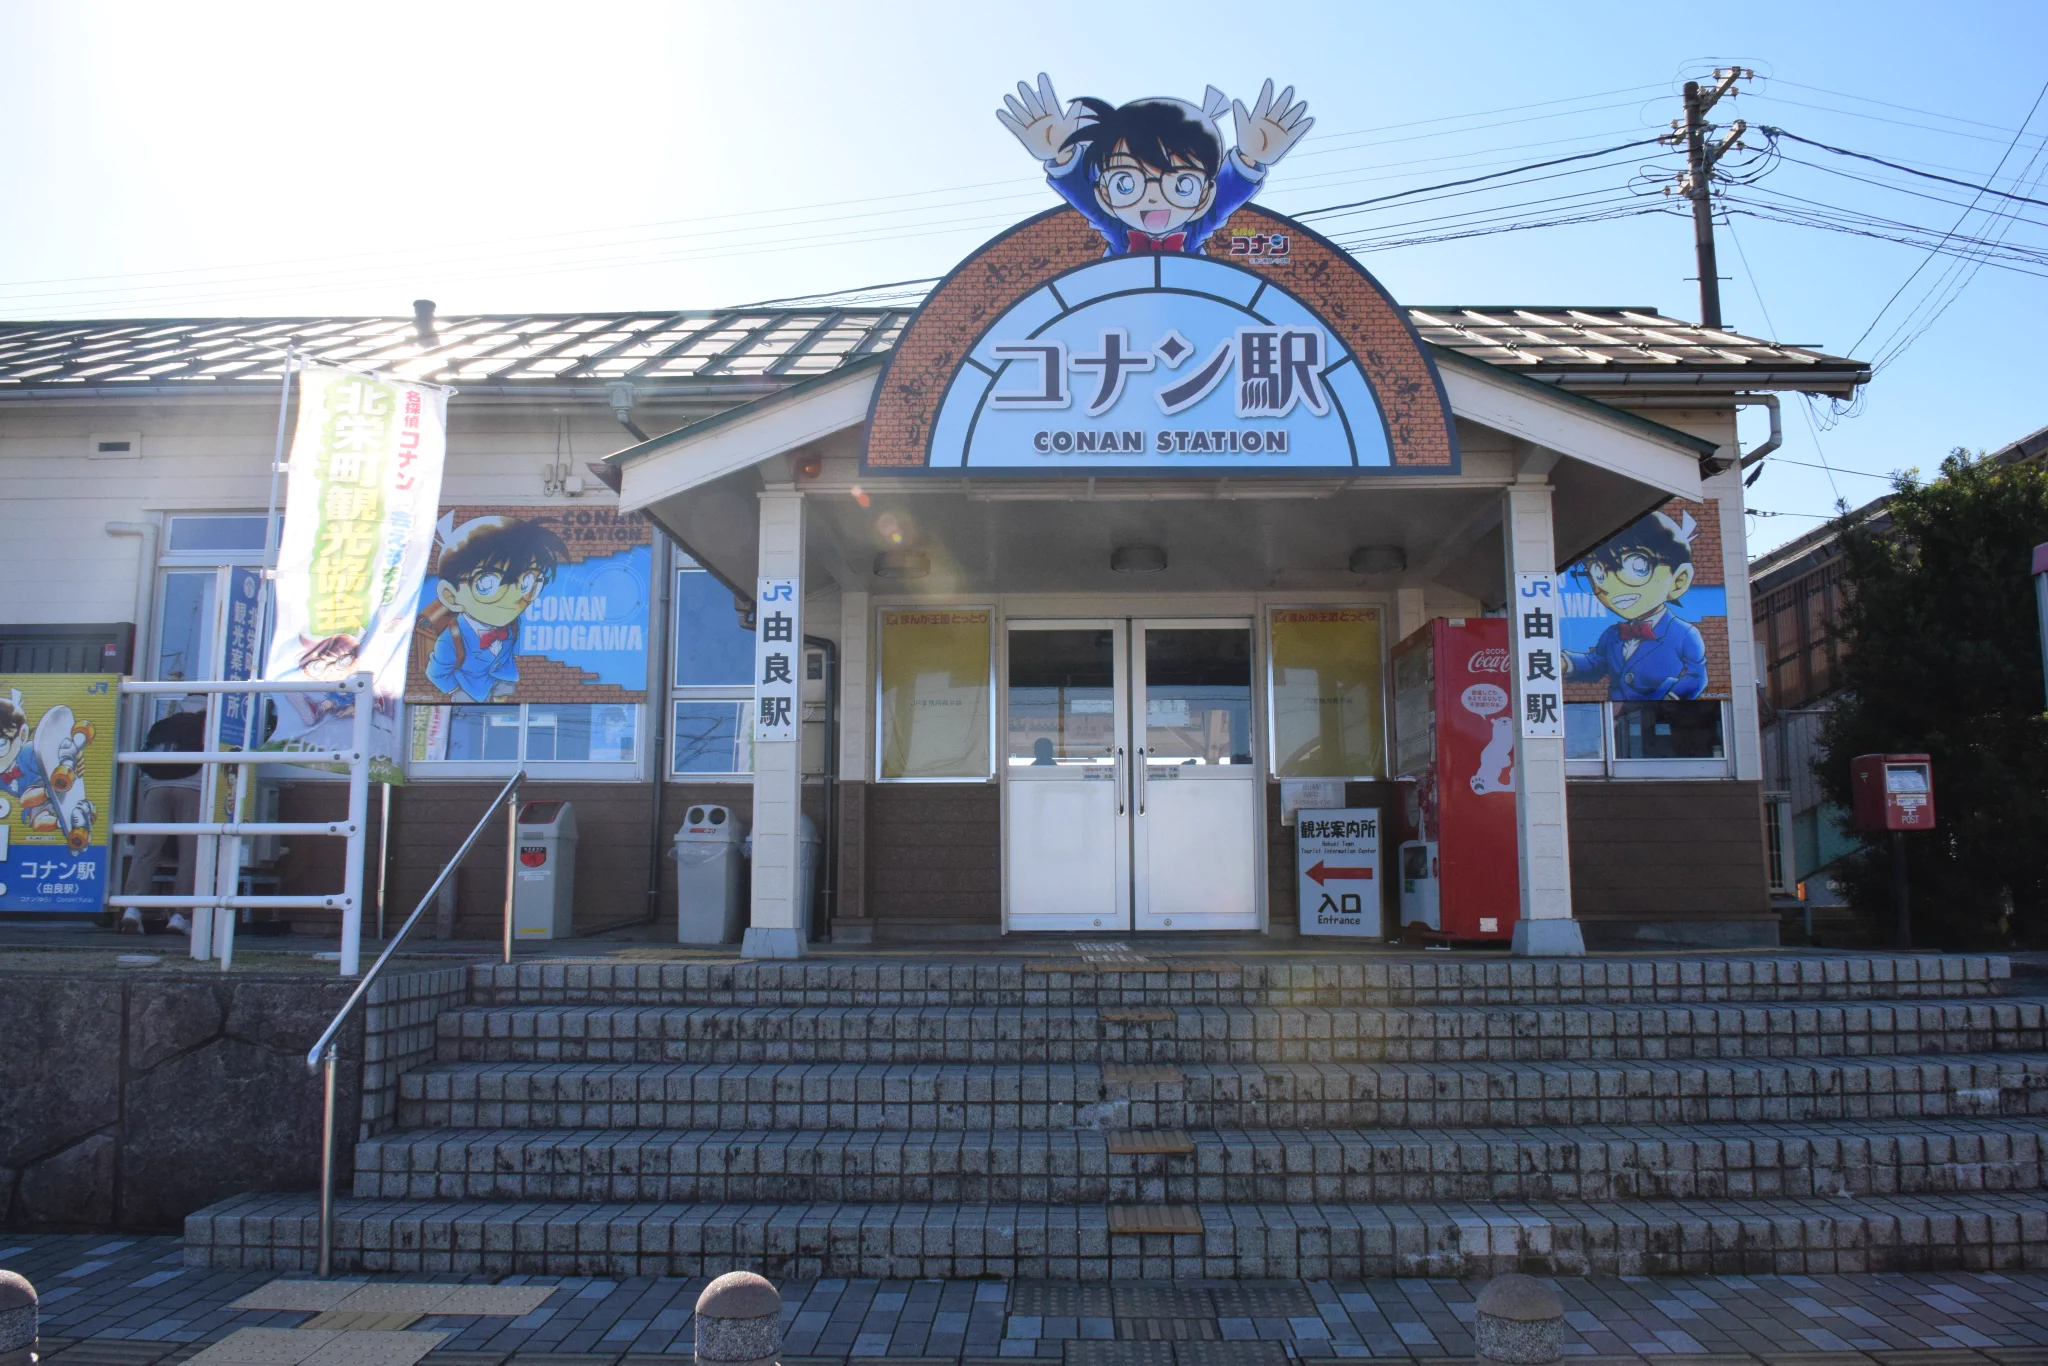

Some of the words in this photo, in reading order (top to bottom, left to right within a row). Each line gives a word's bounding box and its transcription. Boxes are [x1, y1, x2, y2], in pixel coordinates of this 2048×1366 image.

[1230, 234, 1290, 255] コナン
[992, 328, 1327, 414] コナン駅
[395, 390, 422, 490] 名探偵コナン
[1034, 431, 1143, 452] CONAN
[1156, 431, 1288, 452] STATION
[315, 381, 388, 631] 北栄町観光協会
[562, 528, 642, 541] STATION
[763, 585, 793, 601] JR
[1522, 581, 1551, 597] JR
[525, 596, 607, 622] CONAN
[524, 624, 643, 650] EDOGAWA
[760, 611, 793, 727] 由良駅
[1524, 607, 1559, 724] 由良駅
[88, 682, 108, 694] JR
[1301, 820, 1376, 839] 観光案内所
[1901, 815, 1919, 824] POST
[20, 861, 96, 880] コナン駅
[1317, 893, 1362, 914] 入口
[1317, 915, 1361, 925] Entrance
